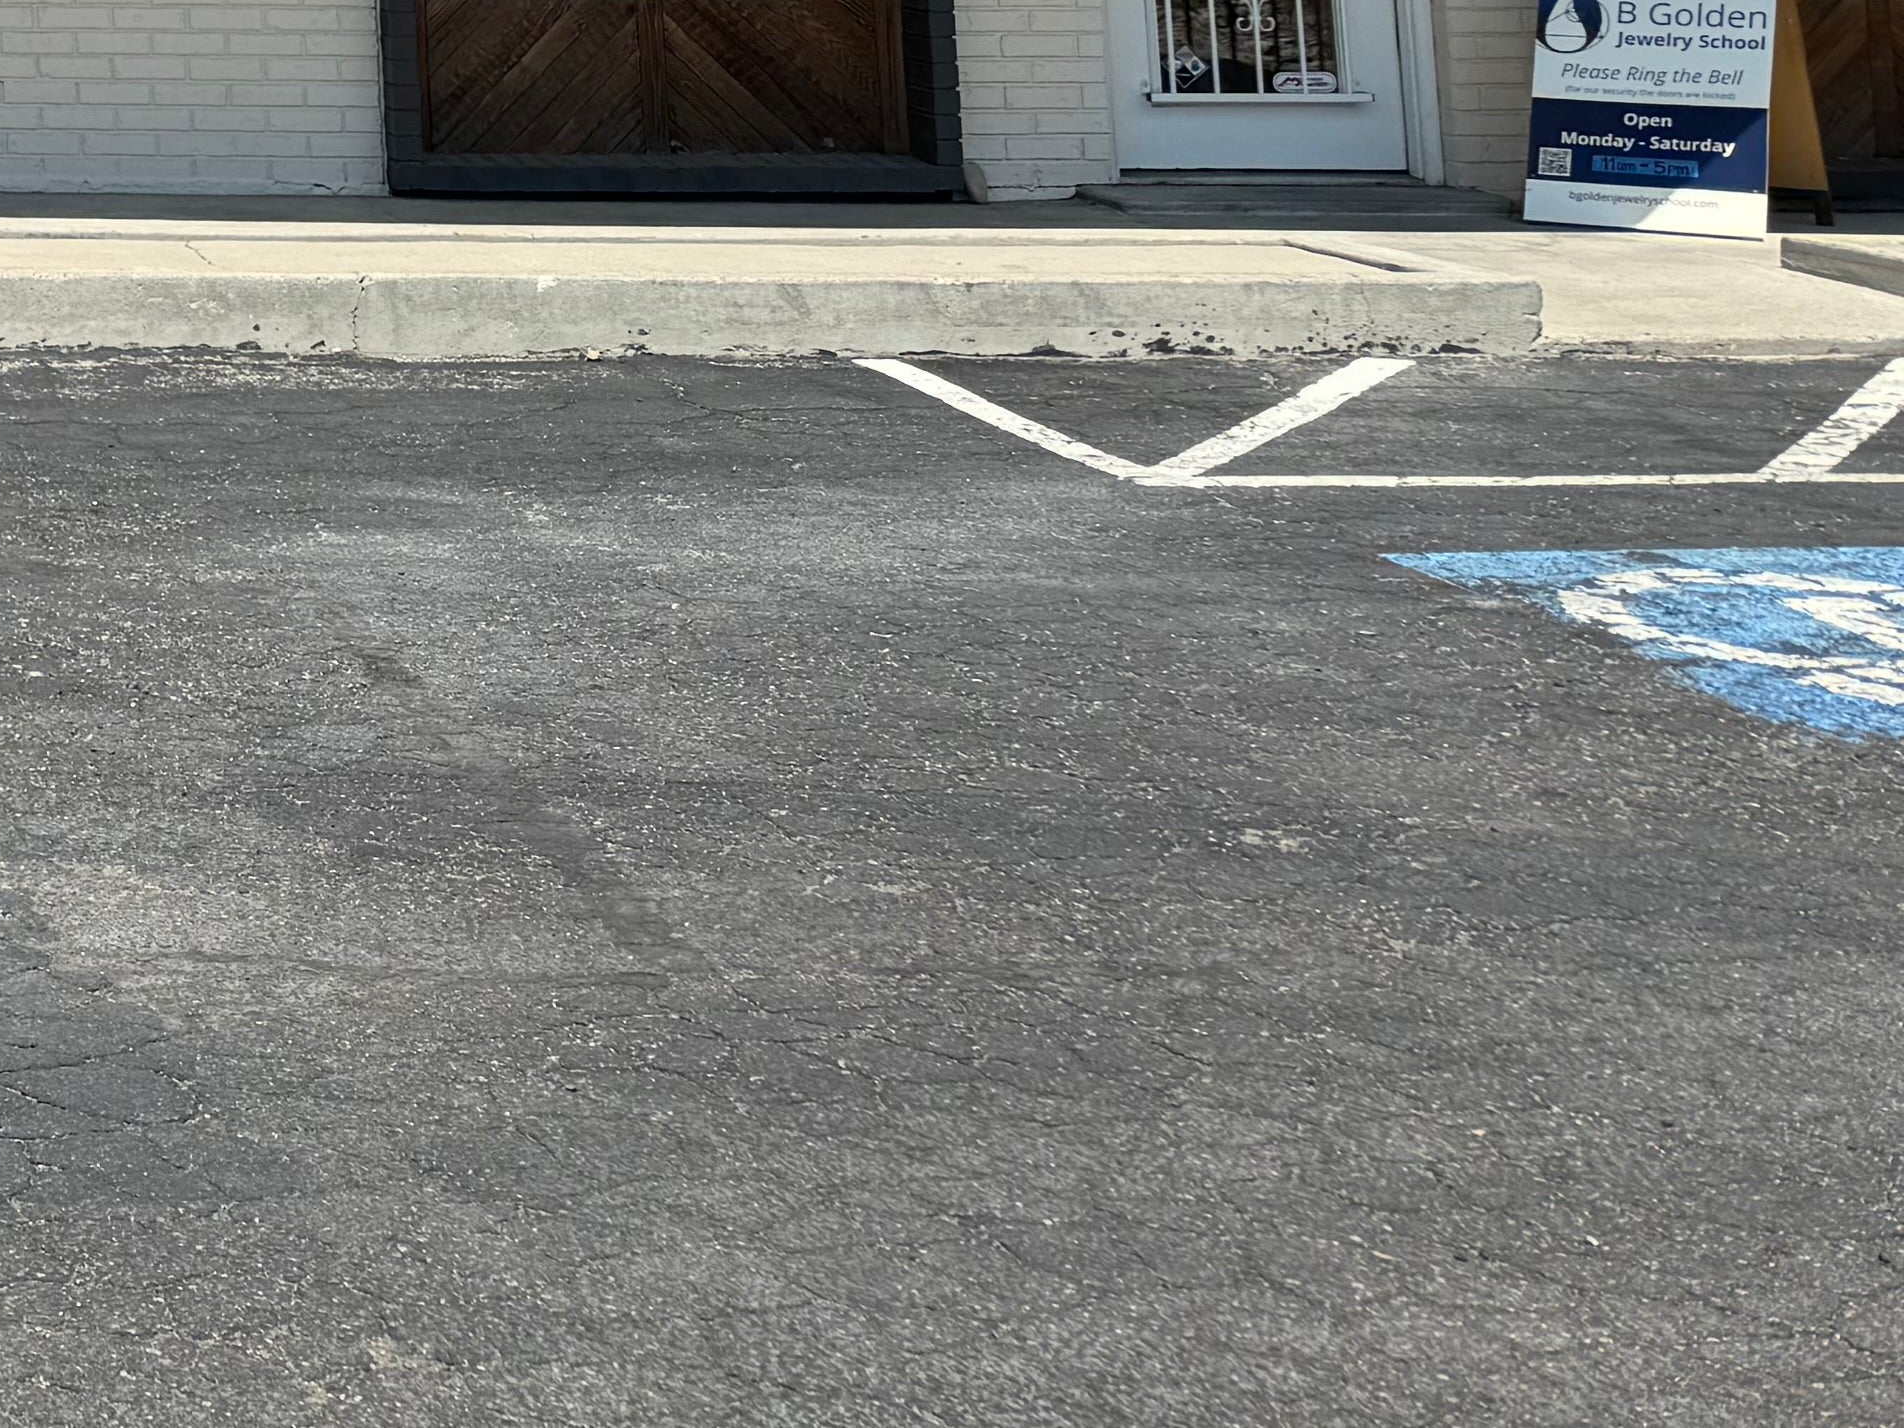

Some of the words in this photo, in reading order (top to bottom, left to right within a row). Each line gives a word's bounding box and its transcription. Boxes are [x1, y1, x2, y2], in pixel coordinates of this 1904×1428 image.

[1617, 1, 1637, 24] B
[1649, 2, 1767, 29] Golden
[1615, 31, 1693, 51] Jewelry
[1698, 34, 1766, 50] School
[1561, 62, 1621, 81] Please
[1627, 66, 1668, 86] Ring
[1672, 68, 1702, 84] the
[1708, 70, 1744, 86] Bell
[1623, 112, 1673, 130] Open
[1560, 131, 1635, 152] Monday
[1649, 135, 1736, 158] Saturday
